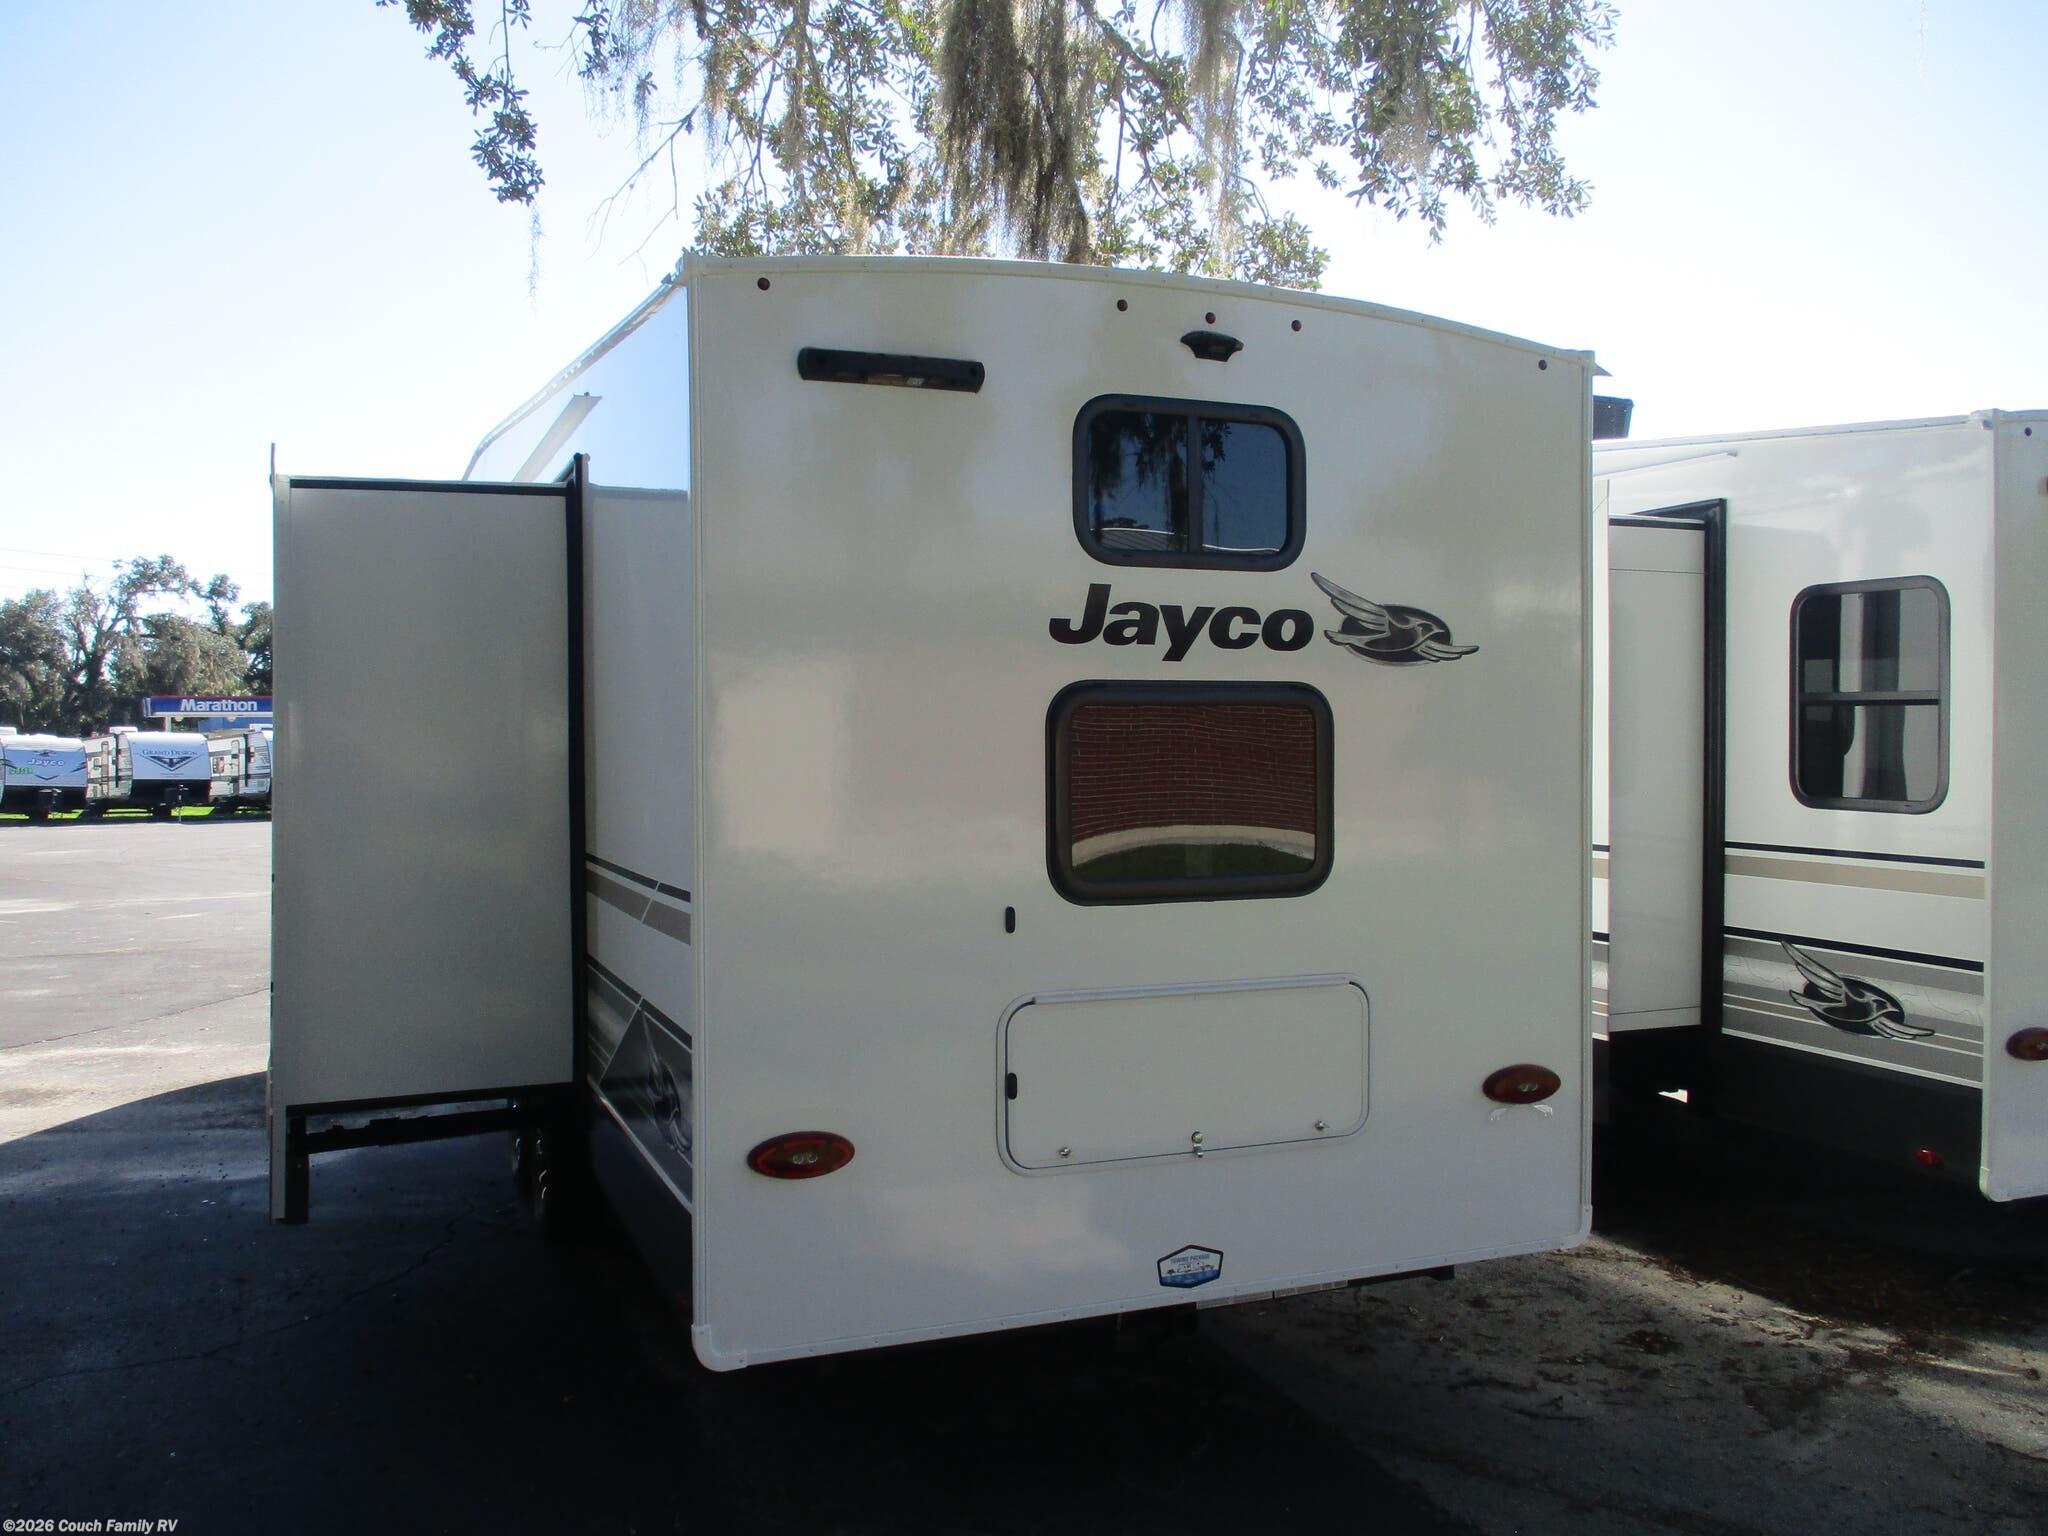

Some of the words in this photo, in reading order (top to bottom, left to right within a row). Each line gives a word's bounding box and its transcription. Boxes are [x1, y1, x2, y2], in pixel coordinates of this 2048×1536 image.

[1049, 583, 1314, 662] Jayco
[180, 699, 258, 711] Marathon
[27, 758, 65, 767] Jayco
